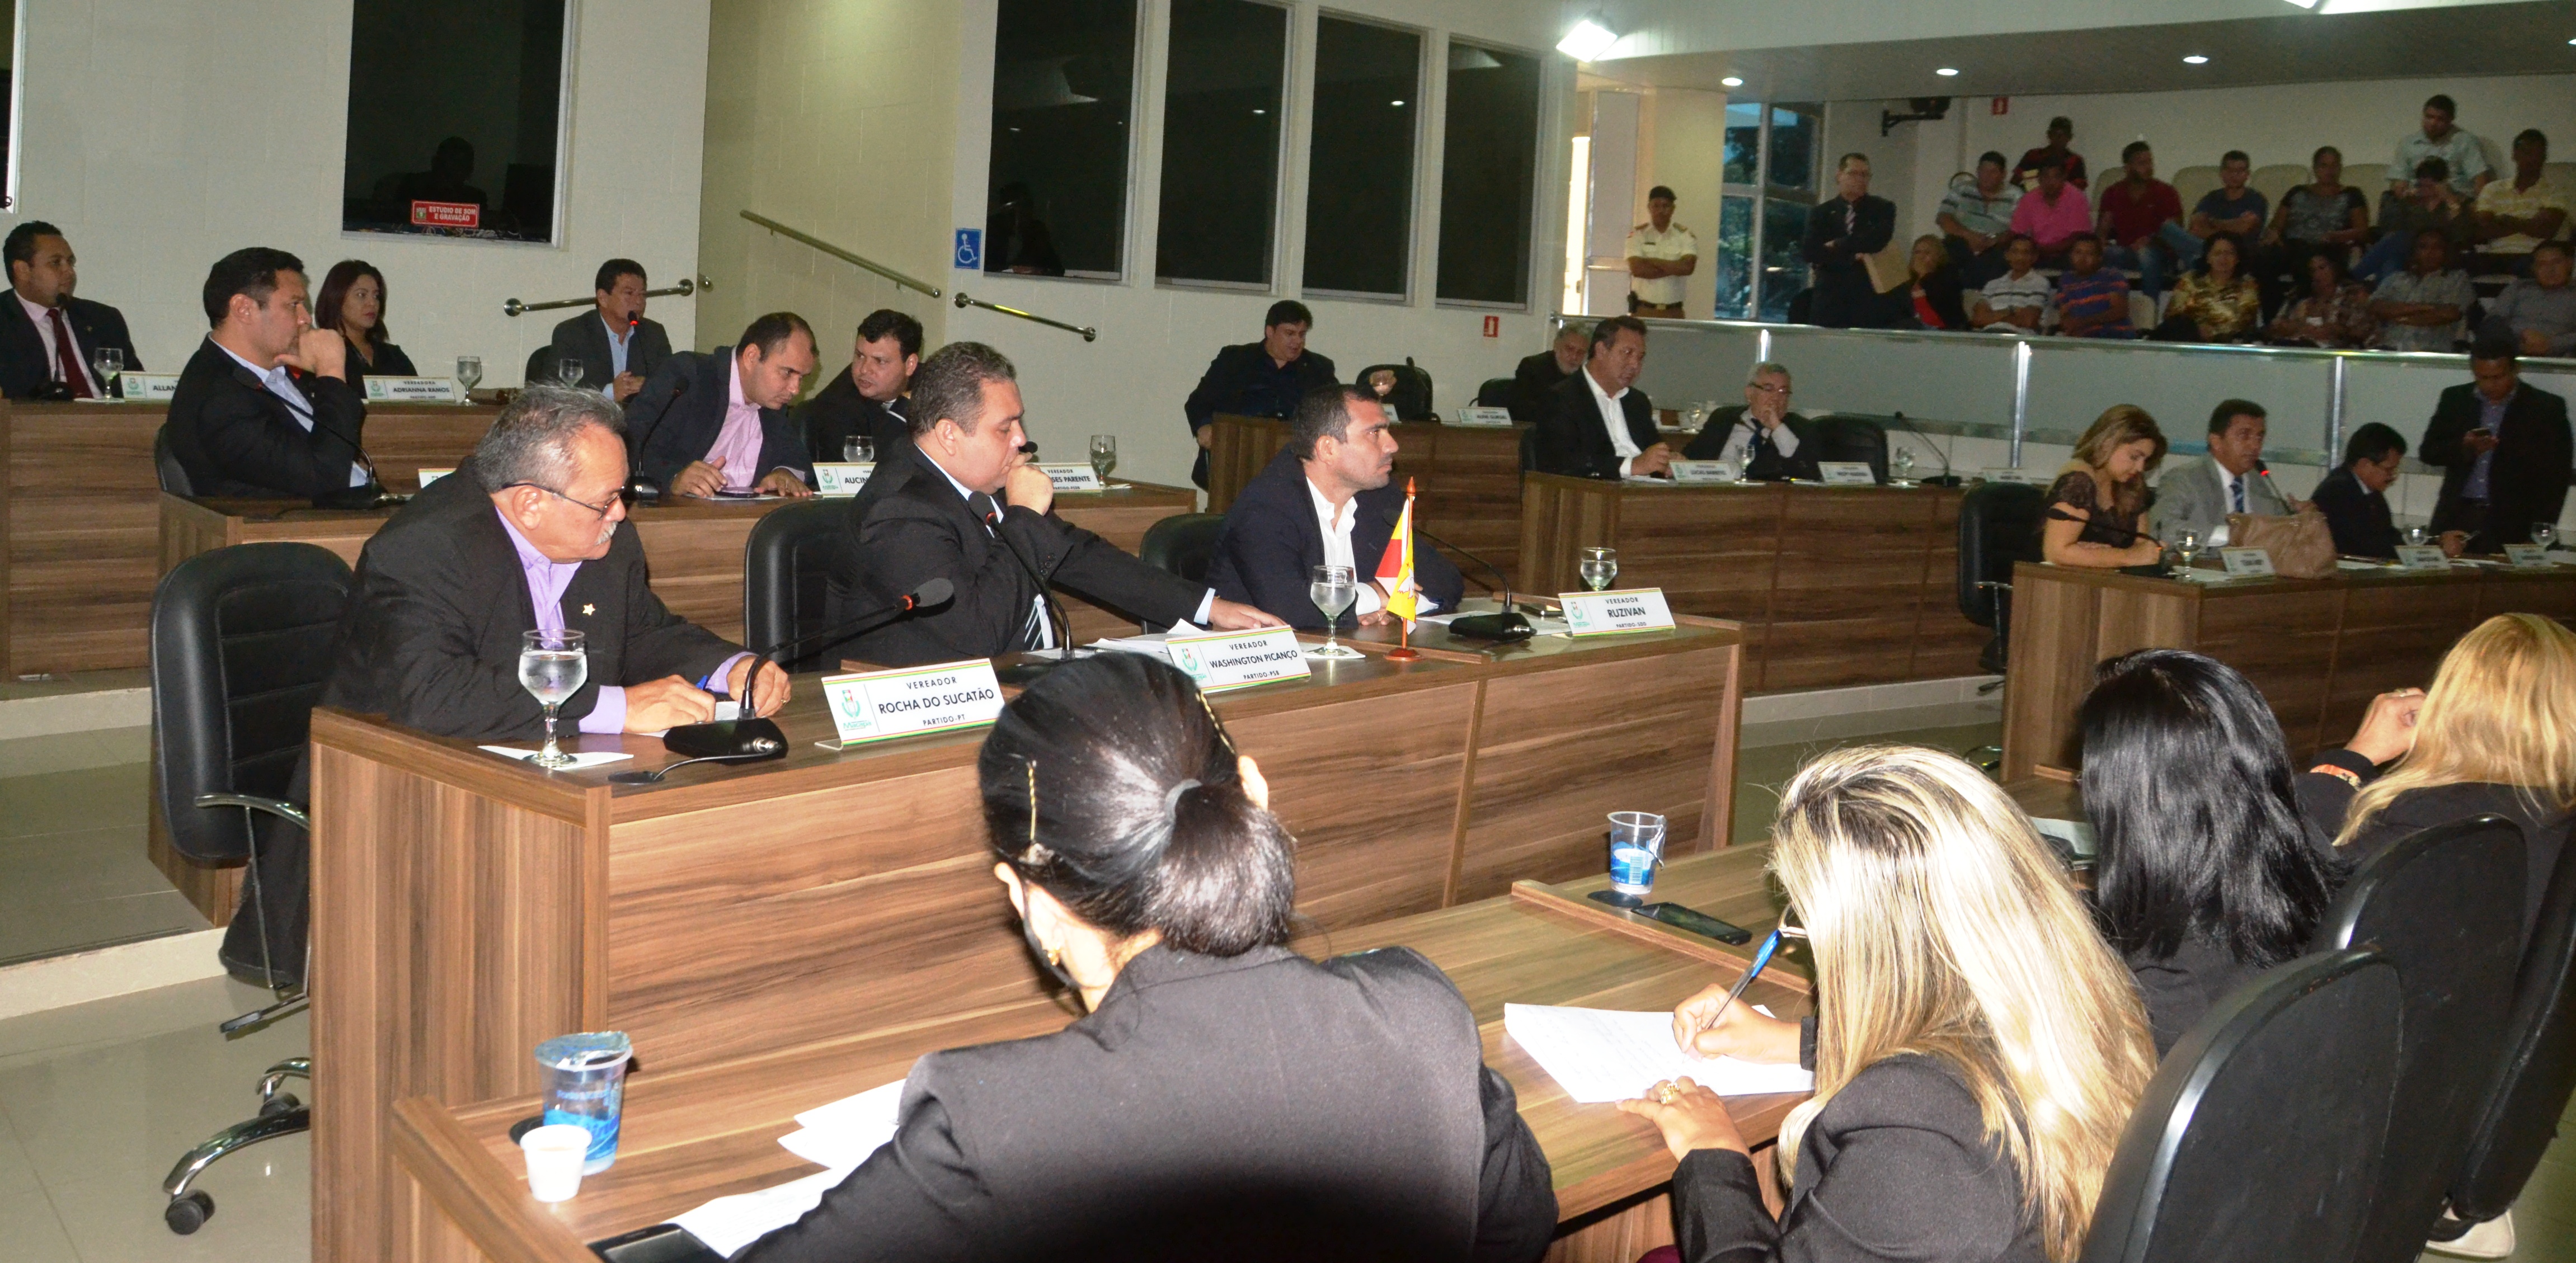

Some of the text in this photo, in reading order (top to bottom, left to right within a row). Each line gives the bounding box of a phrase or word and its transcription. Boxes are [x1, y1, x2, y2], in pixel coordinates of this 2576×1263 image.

[440, 214, 470, 222] GRAVAÇÃO
[1607, 607, 1646, 618] RUZIVAN
[1229, 640, 1268, 651] VEREADOR
[1209, 650, 1298, 668] WASHINGTON PICANÇO
[1243, 671, 1280, 680] PARTIDO-PSB
[906, 676, 957, 690] VEREADOR
[878, 687, 995, 714] ROCHA DO SUCATÃO
[923, 714, 966, 727] PARTIDO-PT
